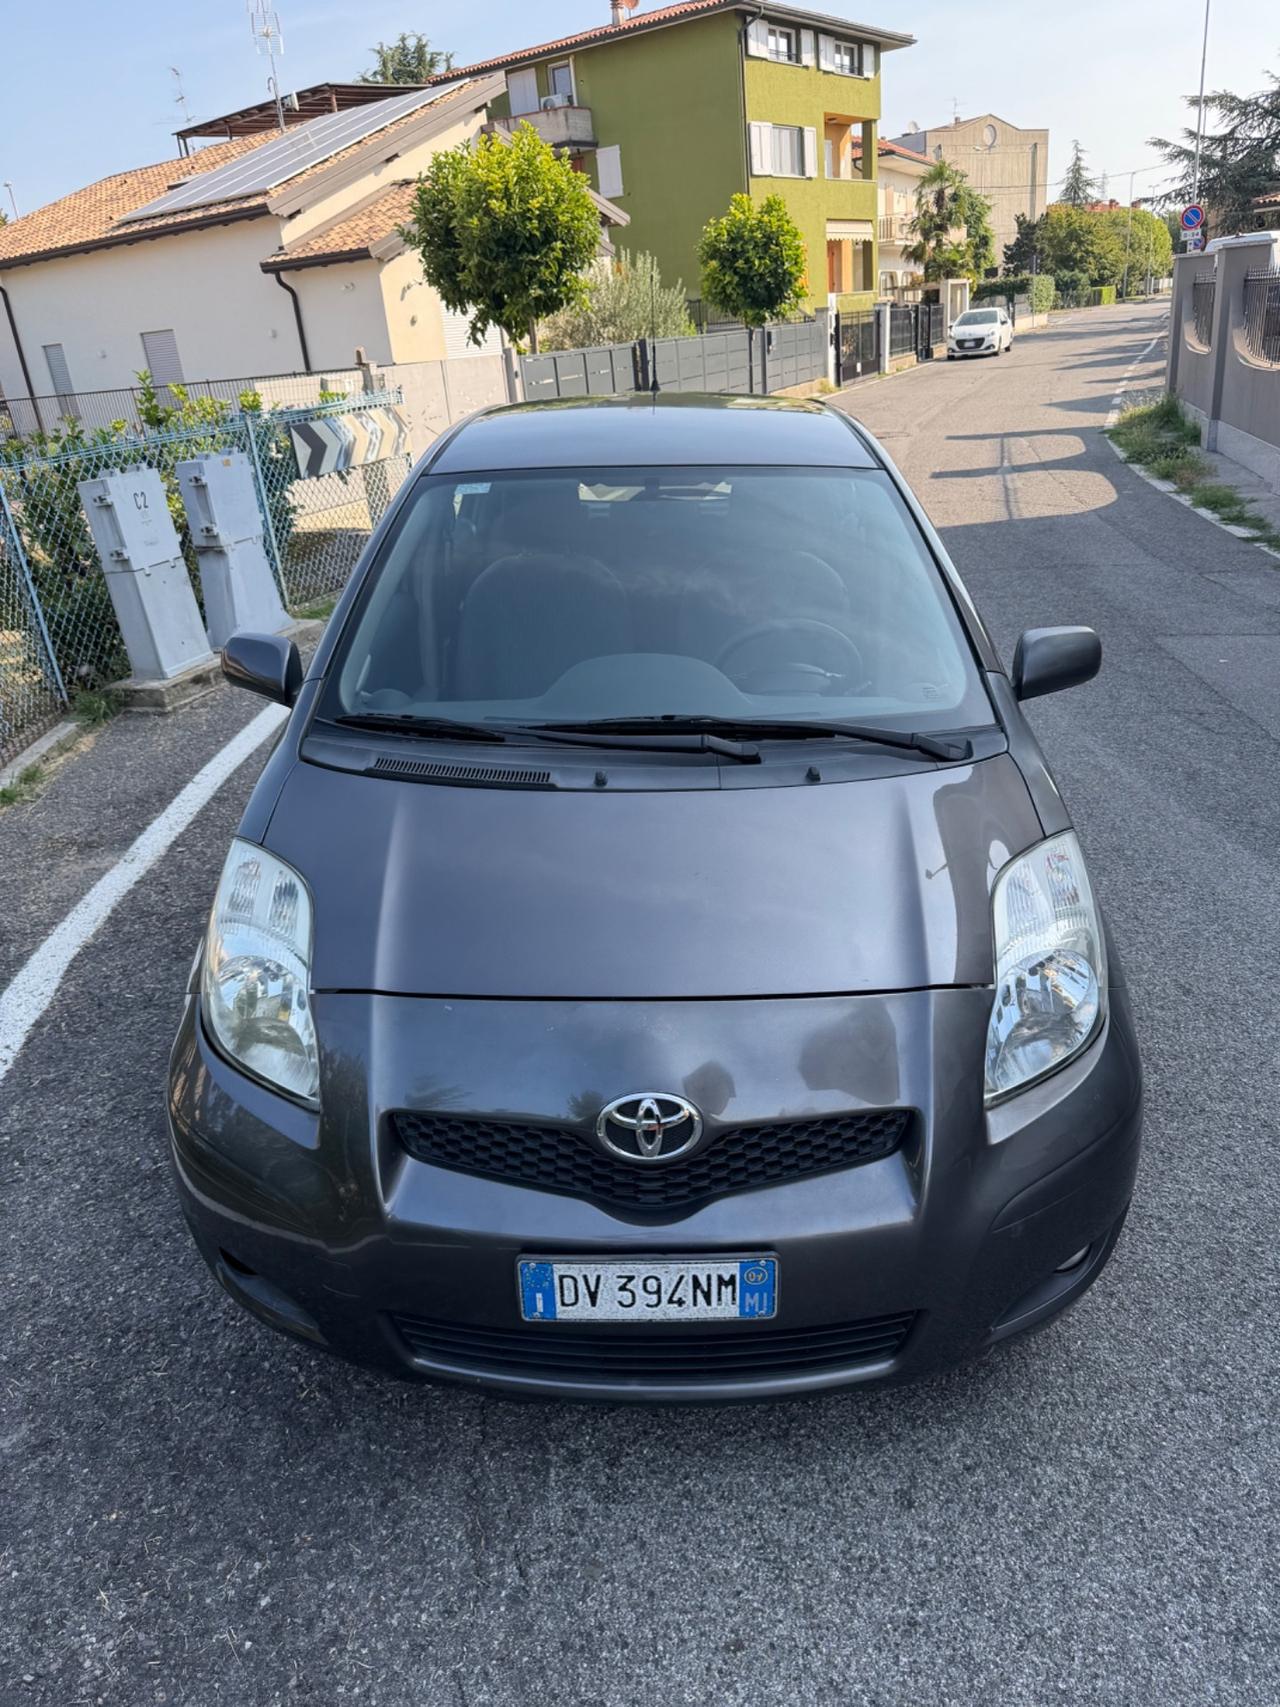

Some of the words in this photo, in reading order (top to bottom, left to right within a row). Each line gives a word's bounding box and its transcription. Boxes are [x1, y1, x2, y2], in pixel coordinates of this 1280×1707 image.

[133, 491, 149, 510] C2
[558, 1274, 601, 1308] DV
[616, 1273, 737, 1308] 394NM
[535, 1292, 544, 1313] I
[745, 1292, 768, 1312] MI
